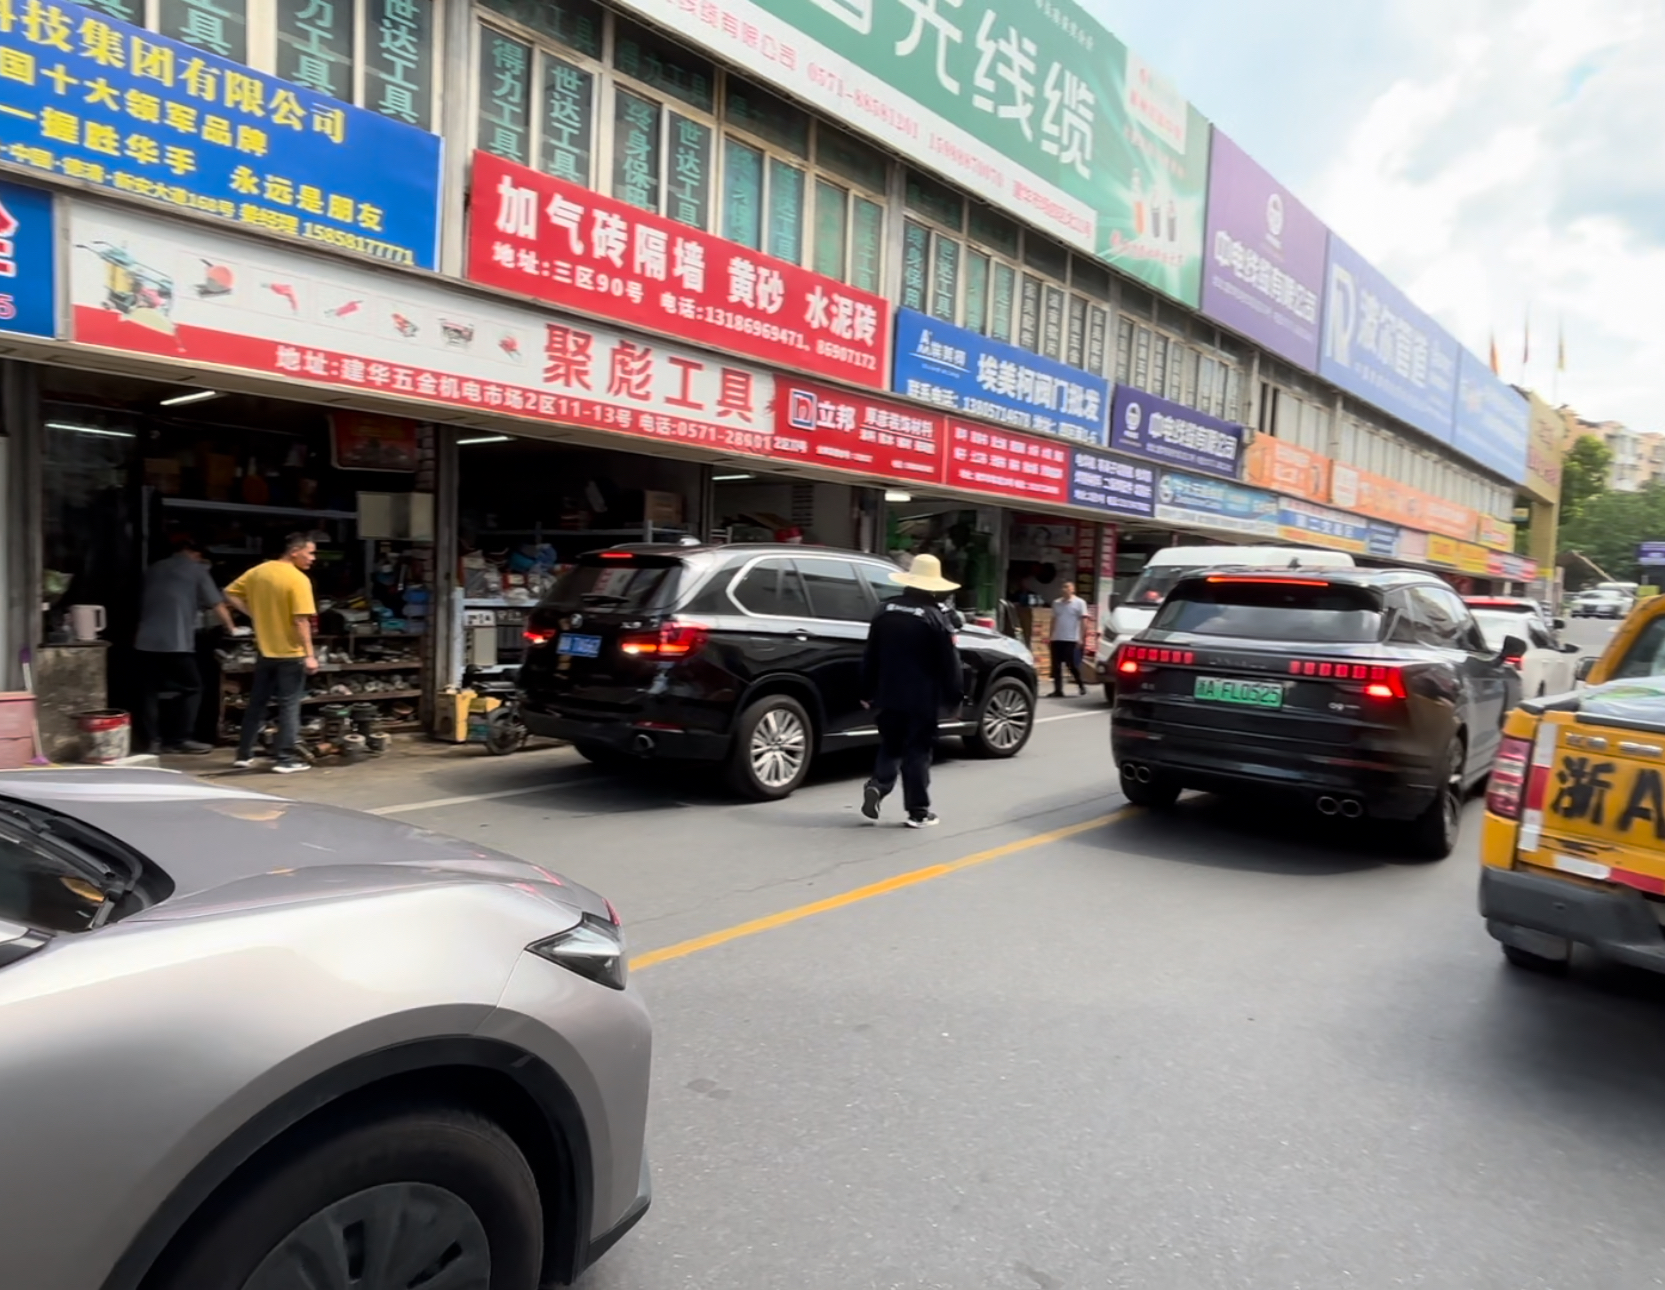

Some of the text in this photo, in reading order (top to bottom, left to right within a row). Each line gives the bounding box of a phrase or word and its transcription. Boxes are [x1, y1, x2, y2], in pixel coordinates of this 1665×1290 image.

[489, 38, 525, 163] 得力工具
[549, 66, 583, 182] 世达工具
[229, 165, 384, 232] 永远是朋友
[676, 120, 703, 228] 世达工具
[496, 176, 877, 347] 加气砖隔墙 黄砂 水泥砖
[542, 323, 755, 423] 聚彪工具
[817, 401, 857, 433] 立邦
